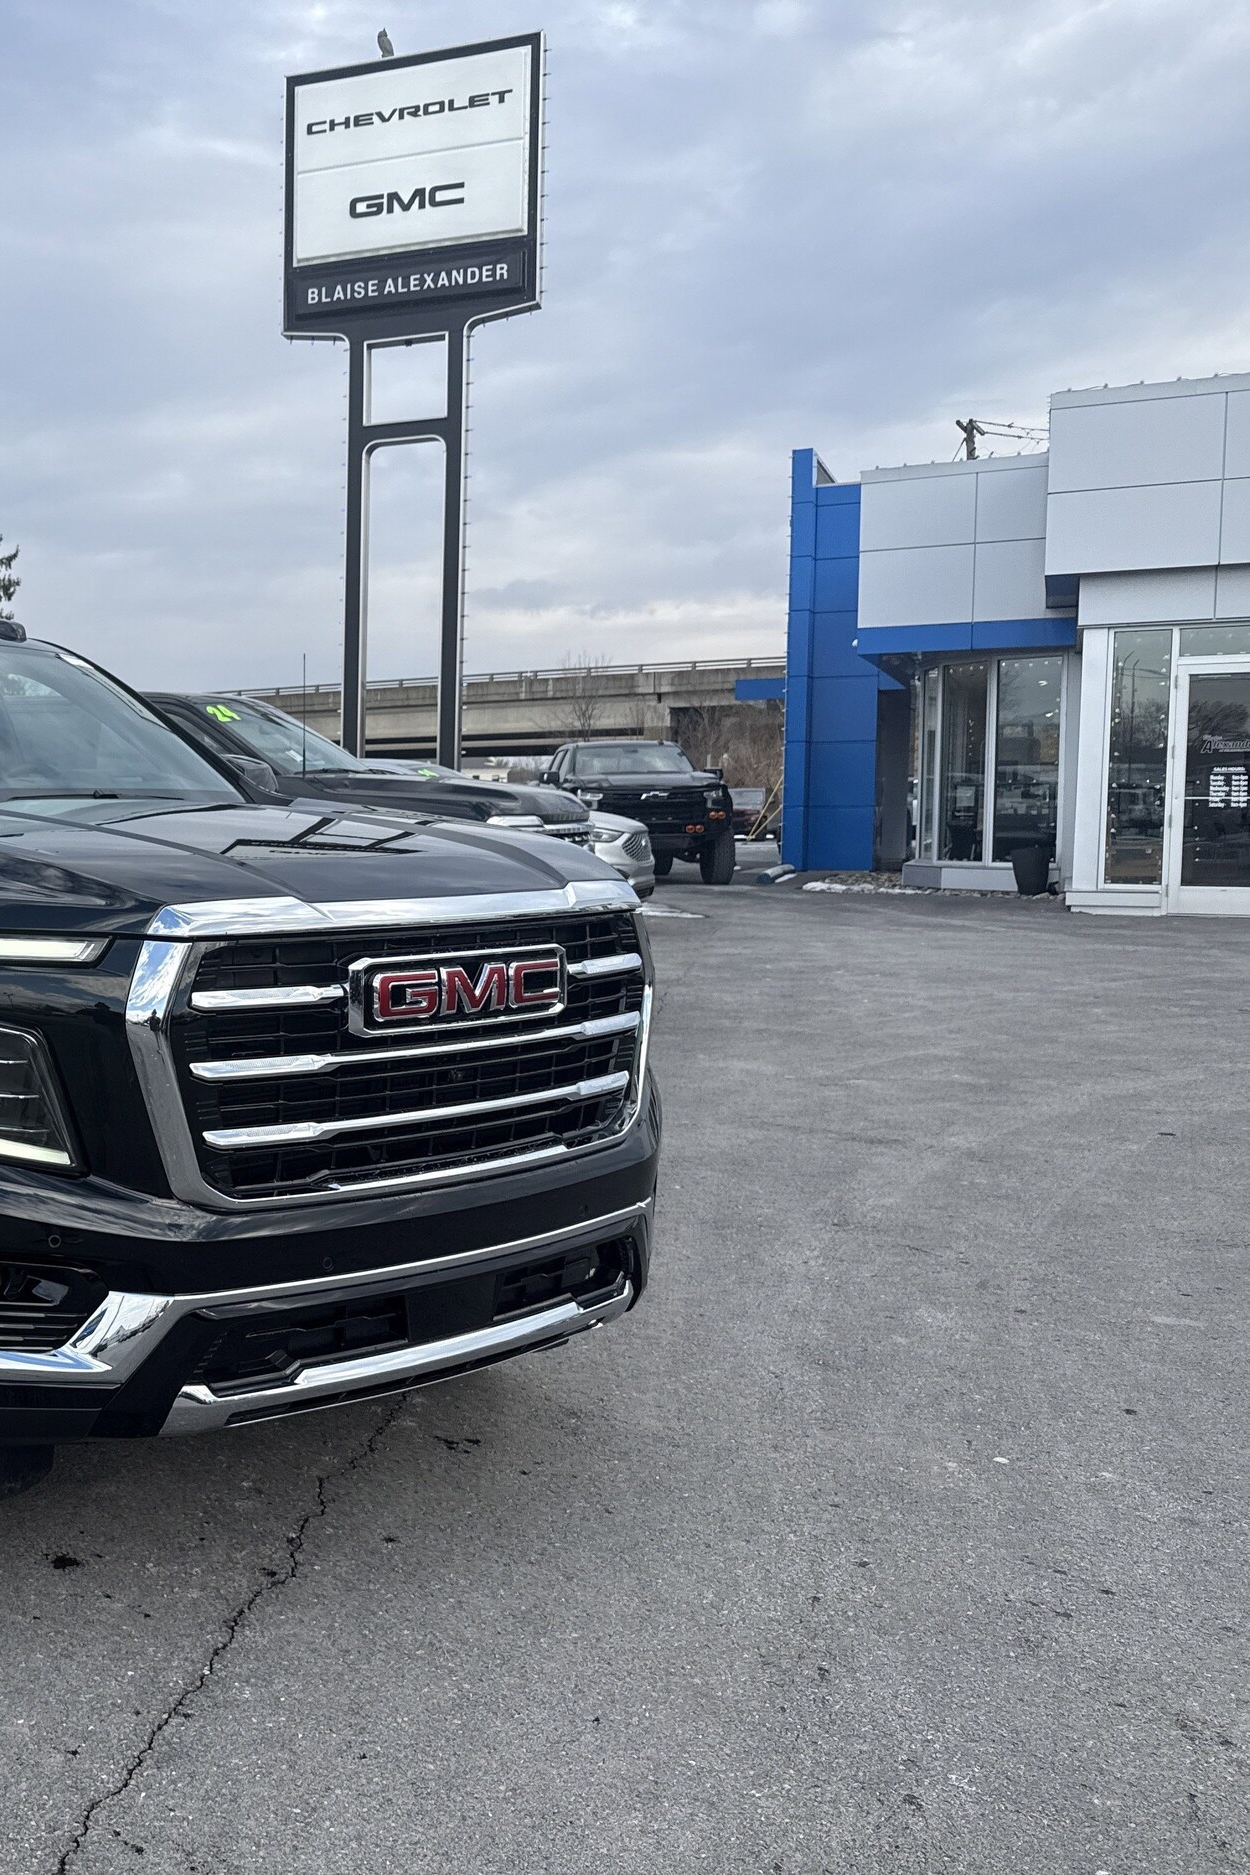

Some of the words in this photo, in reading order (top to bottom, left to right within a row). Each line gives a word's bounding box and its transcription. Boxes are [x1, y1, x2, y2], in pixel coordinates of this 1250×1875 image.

[307, 89, 513, 135] CHEVROLET
[349, 181, 465, 219] GMC
[307, 280, 379, 305] BLAISE
[383, 263, 509, 295] ALEXANDER
[206, 705, 242, 723] 24
[372, 957, 561, 1023] GMC
